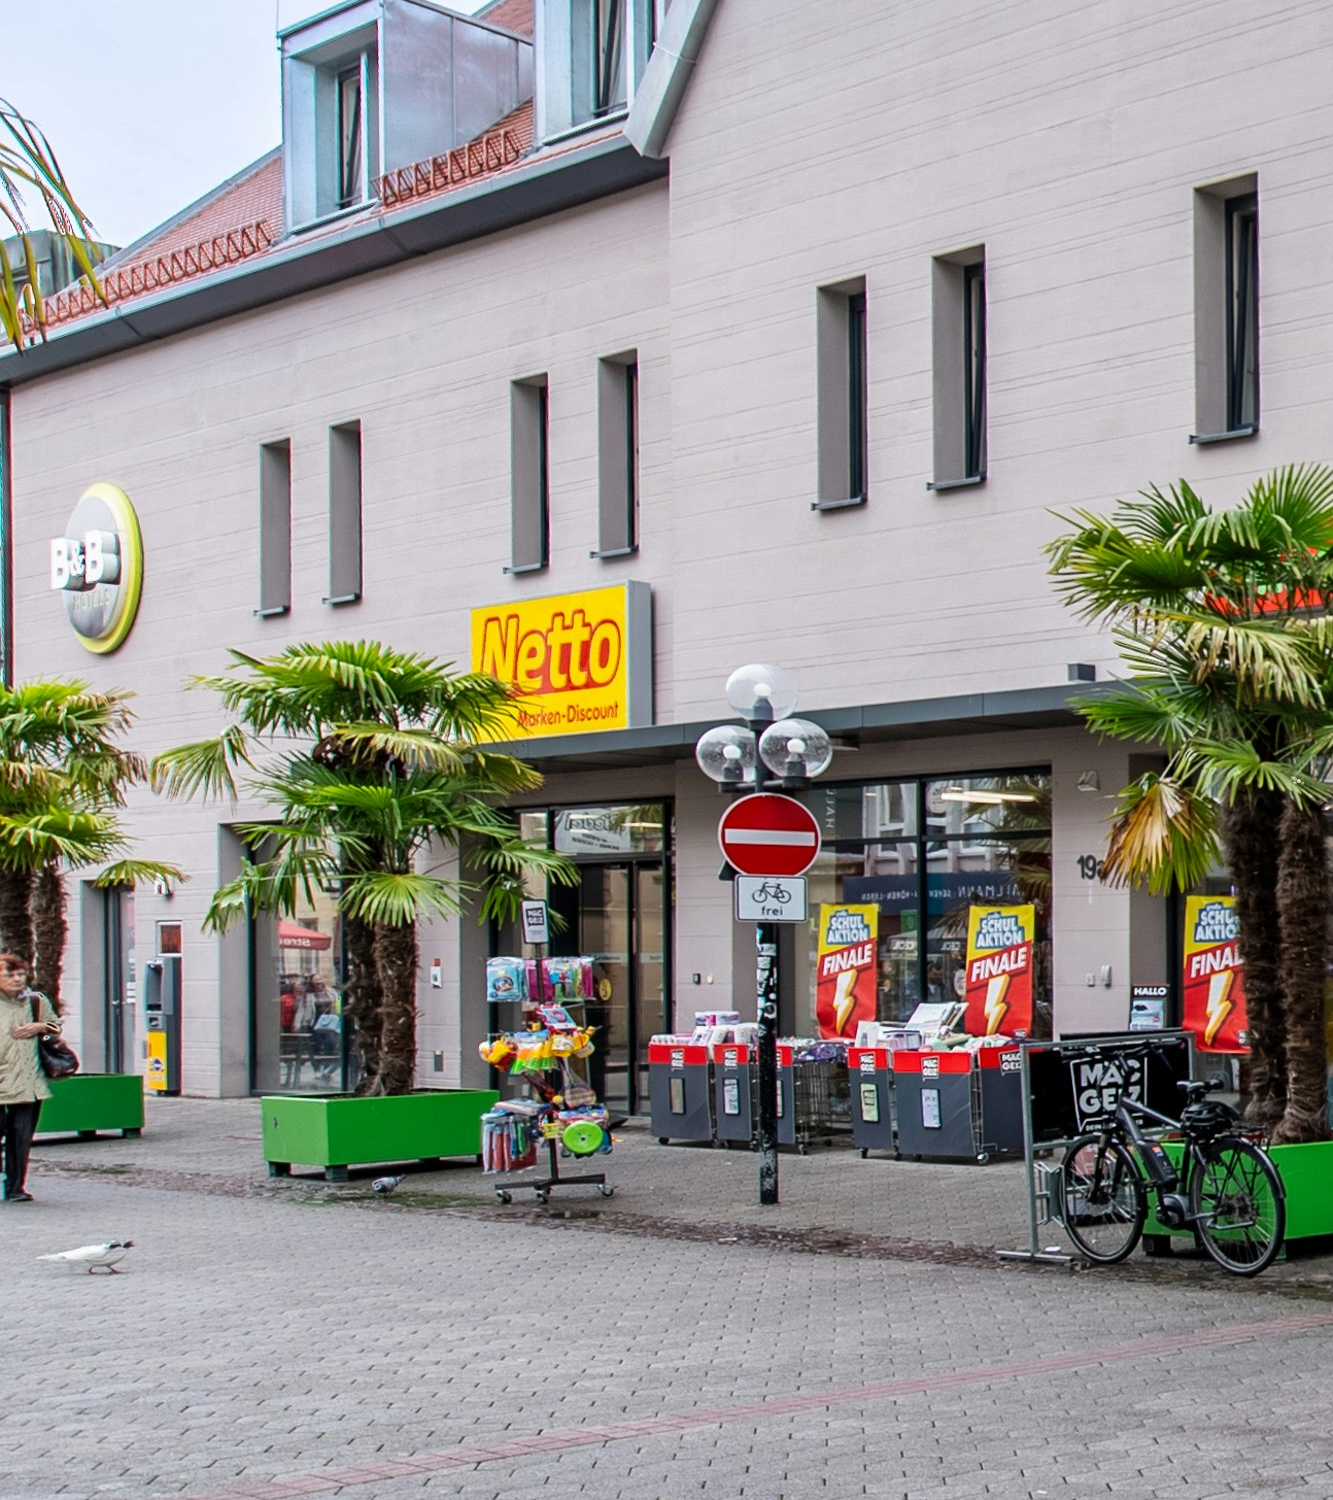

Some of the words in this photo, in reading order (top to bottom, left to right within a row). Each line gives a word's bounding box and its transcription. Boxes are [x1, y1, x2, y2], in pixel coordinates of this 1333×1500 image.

[51, 529, 115, 589] B&B
[73, 589, 110, 611] HOTELS
[481, 608, 622, 697] Netto
[517, 700, 619, 728] Marken-Discount
[761, 905, 784, 916] frei
[1200, 909, 1239, 926] SCHU
[830, 915, 864, 930] SCHUL
[981, 917, 1019, 933] SCHUL
[827, 928, 869, 943] AKTION
[976, 930, 1024, 948] AKTION
[1195, 925, 1240, 941] AKTIO
[823, 943, 873, 976] FINALE
[971, 947, 1027, 982] FINALE
[1190, 945, 1244, 979] FINAL
[1134, 987, 1167, 996] HALLO
[1080, 1059, 1141, 1087] MÄC
